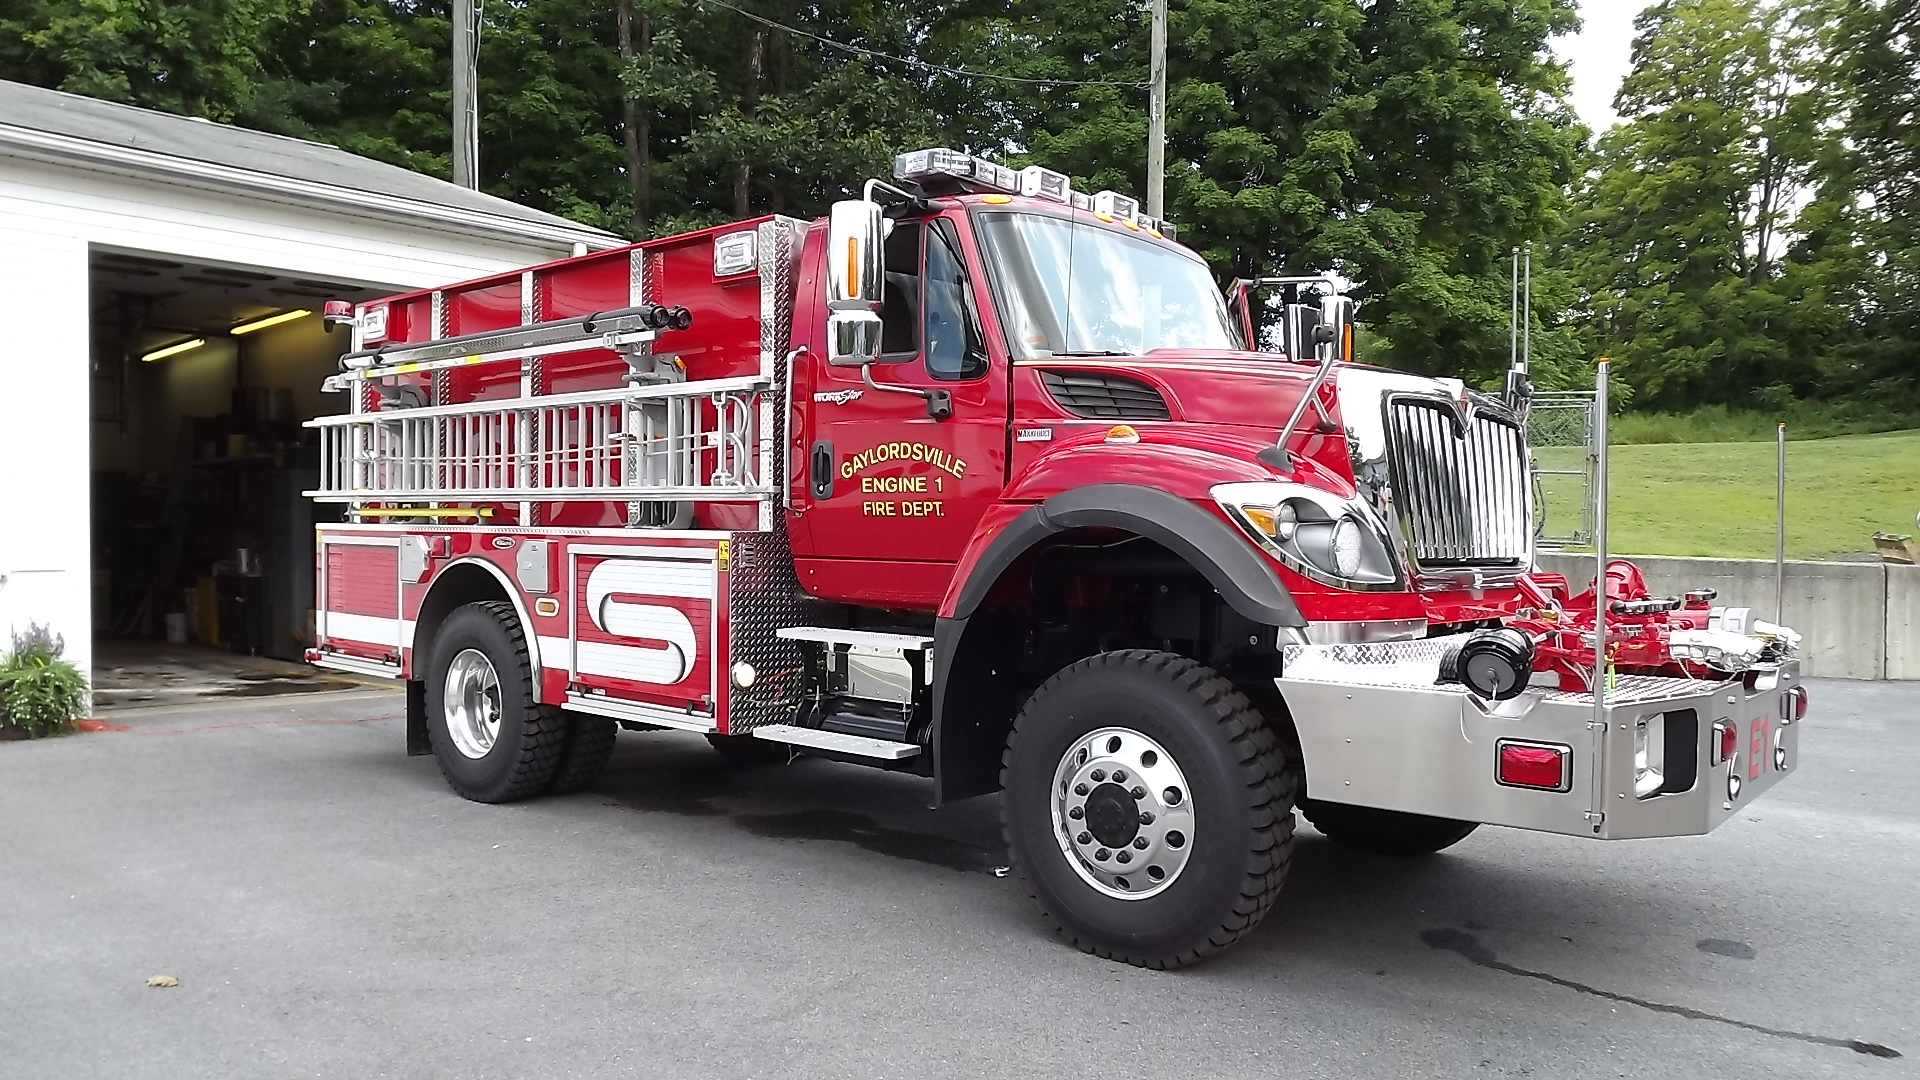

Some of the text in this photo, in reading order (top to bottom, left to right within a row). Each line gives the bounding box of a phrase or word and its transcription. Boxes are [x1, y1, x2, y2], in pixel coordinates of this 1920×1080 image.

[841, 441, 967, 479] GAYLORDSVILLE
[861, 476, 943, 493] ENGINE 1
[863, 501, 945, 517] FIRE DEPT.
[1748, 712, 1770, 782] E1
